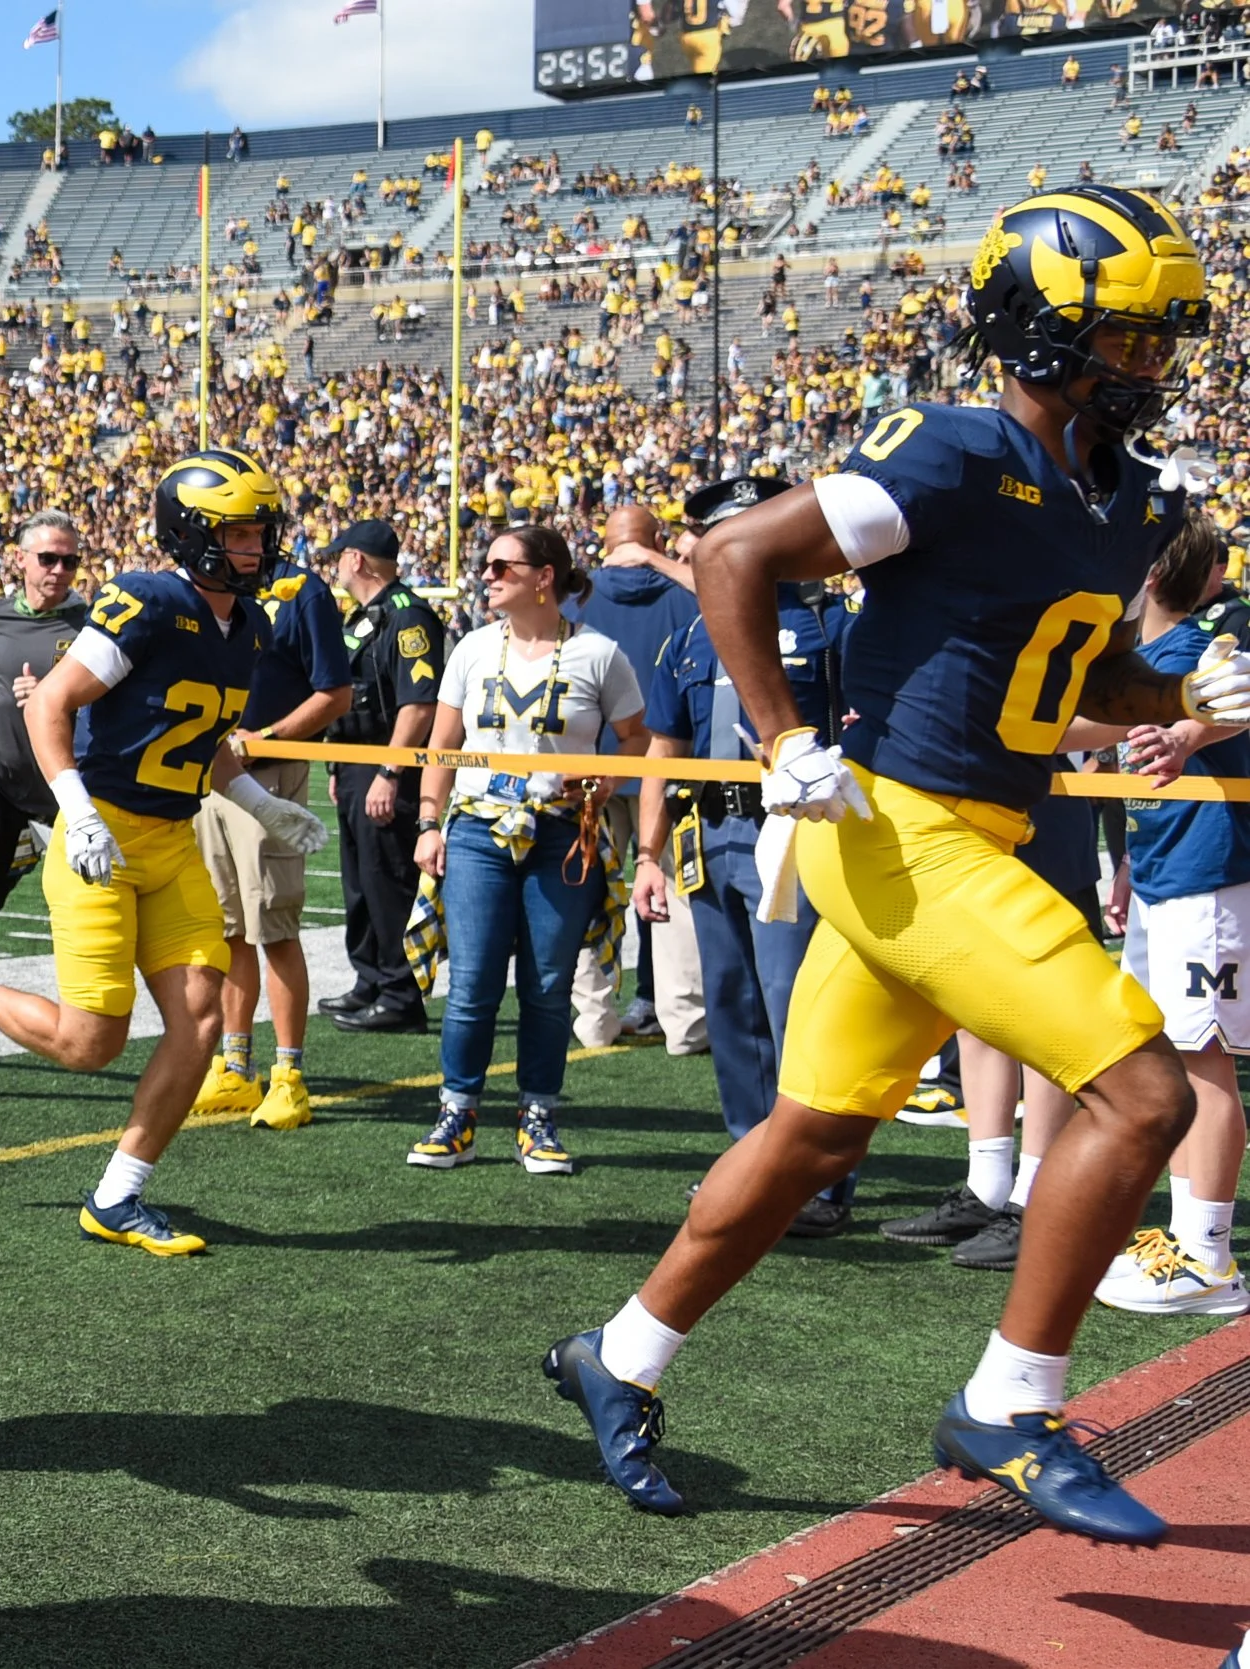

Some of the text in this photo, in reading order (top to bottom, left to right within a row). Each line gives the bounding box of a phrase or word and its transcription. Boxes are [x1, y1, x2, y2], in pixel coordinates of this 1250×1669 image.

[538, 44, 628, 86] 25:52
[860, 408, 924, 462] 0
[90, 582, 144, 634] 27
[995, 591, 1124, 755] 0
[477, 677, 571, 736] M
[414, 752, 489, 768] M MICHIGAN
[1186, 962, 1239, 1000] M
